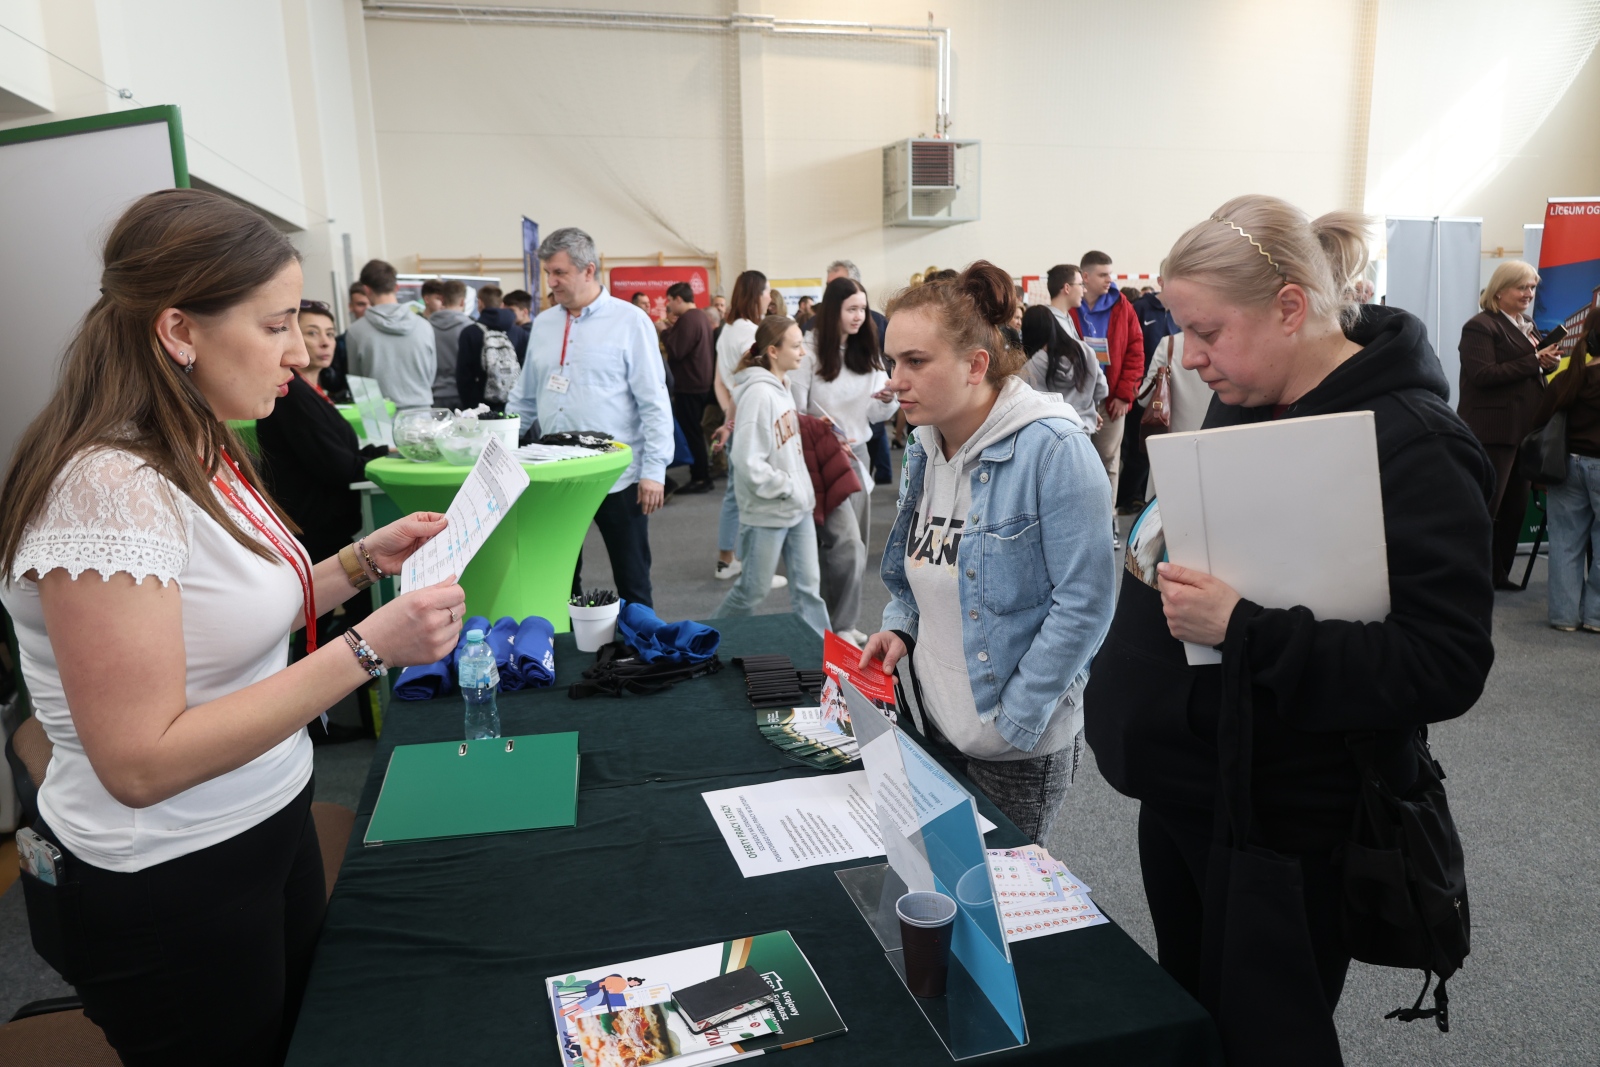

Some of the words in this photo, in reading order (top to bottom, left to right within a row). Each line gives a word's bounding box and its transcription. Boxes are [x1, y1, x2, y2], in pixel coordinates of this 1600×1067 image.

[1550, 206, 1584, 216] LICEUM
[907, 511, 964, 567] VAN
[720, 804, 734, 819] STAŻY
[731, 822, 744, 839] PRACY
[740, 838, 758, 858] OFERTY
[782, 990, 799, 1016] Krajowy
